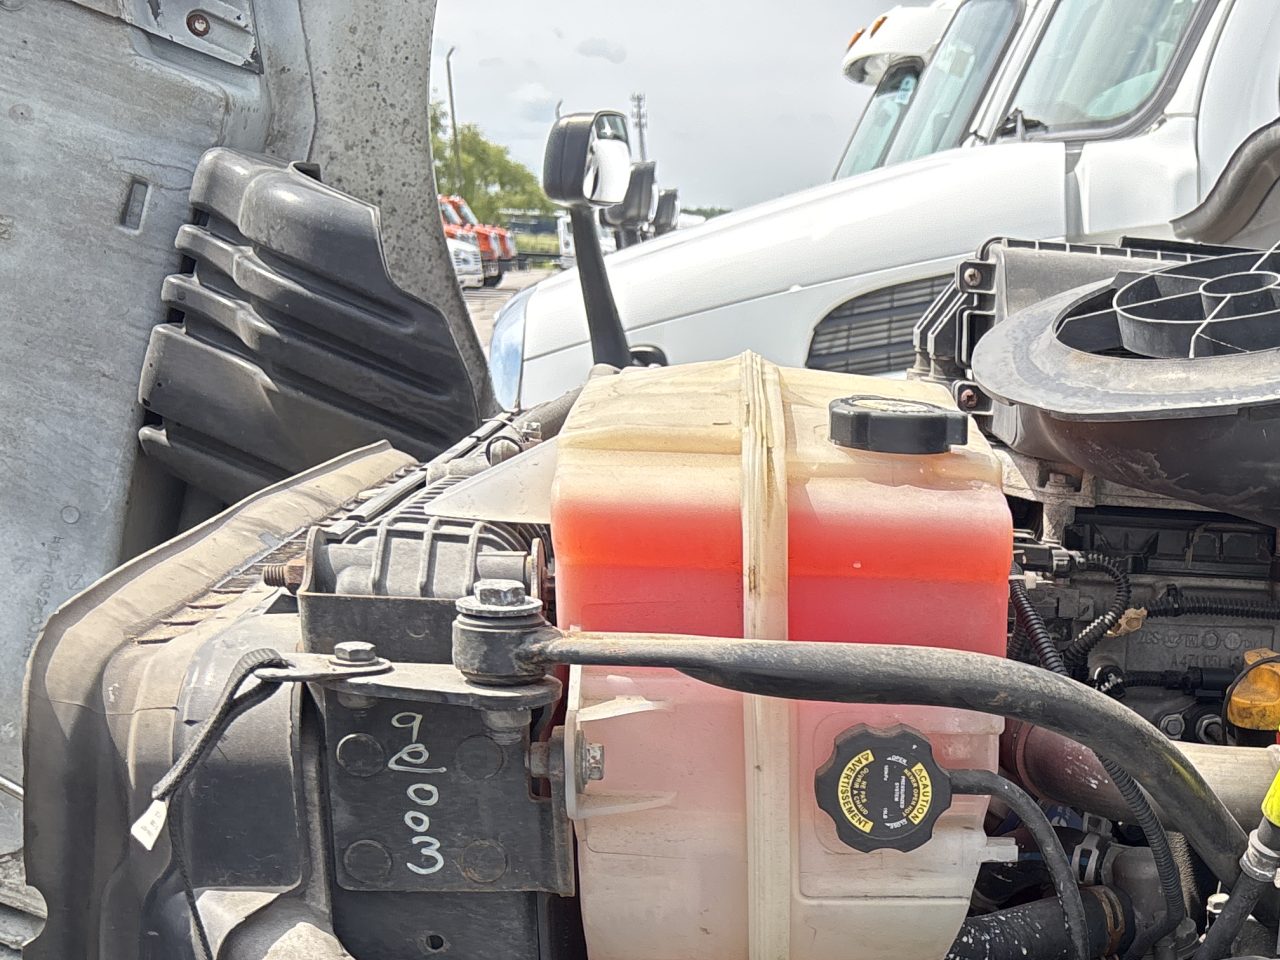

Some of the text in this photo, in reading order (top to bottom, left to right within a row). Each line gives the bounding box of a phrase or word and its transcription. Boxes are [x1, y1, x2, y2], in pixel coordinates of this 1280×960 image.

[840, 757, 869, 829] AVERTISSEMENT
[853, 767, 869, 790] OUVRIR
[902, 768, 919, 817] NEVER OPEN HOT
[910, 776, 930, 822] CAUTION
[853, 795, 868, 815] CHAUD
